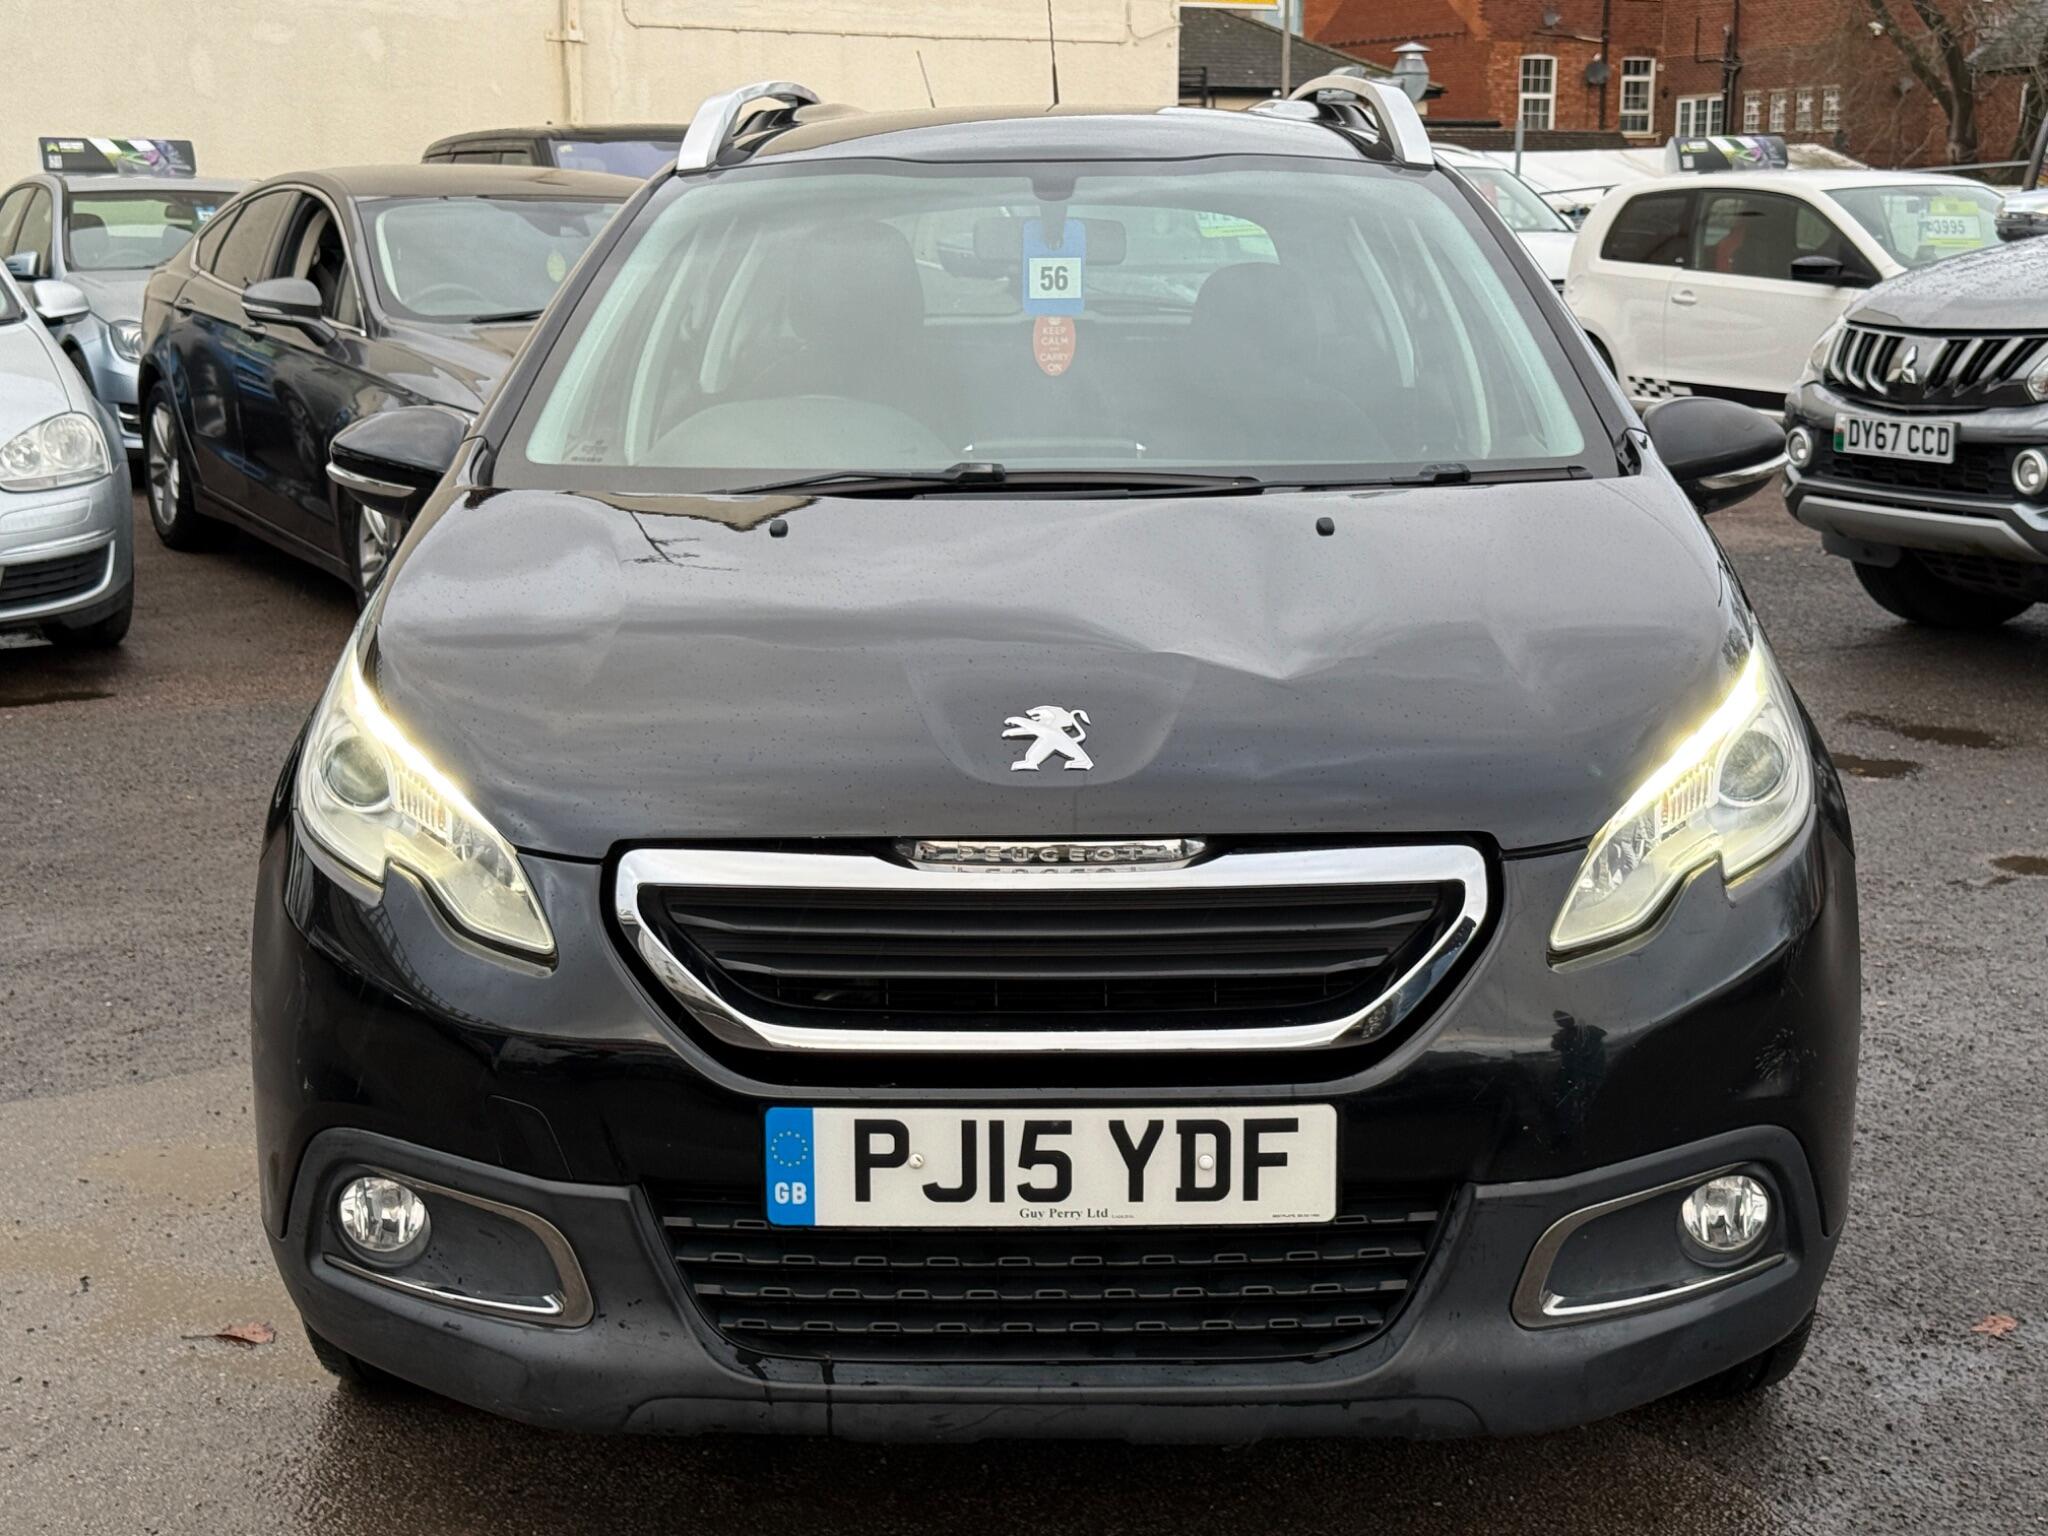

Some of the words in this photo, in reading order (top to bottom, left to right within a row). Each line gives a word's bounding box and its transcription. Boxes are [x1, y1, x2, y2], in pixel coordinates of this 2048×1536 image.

[1040, 265, 1068, 291] 56
[1042, 327, 1067, 336] KEEP
[1041, 336, 1068, 346] CALM
[1040, 353, 1069, 362] CARRY
[1047, 363, 1063, 372] ON
[1848, 419, 1901, 451] DY67
[1907, 424, 1950, 456] CCD
[956, 845, 1144, 862] PEUGEOT
[854, 1118, 1072, 1203] PJ15
[1108, 1118, 1299, 1202] YDF
[774, 1181, 808, 1205] GB
[1019, 1207, 1045, 1221] Guy
[1049, 1207, 1082, 1221] Perry
[1087, 1207, 1109, 1219] Ltd
